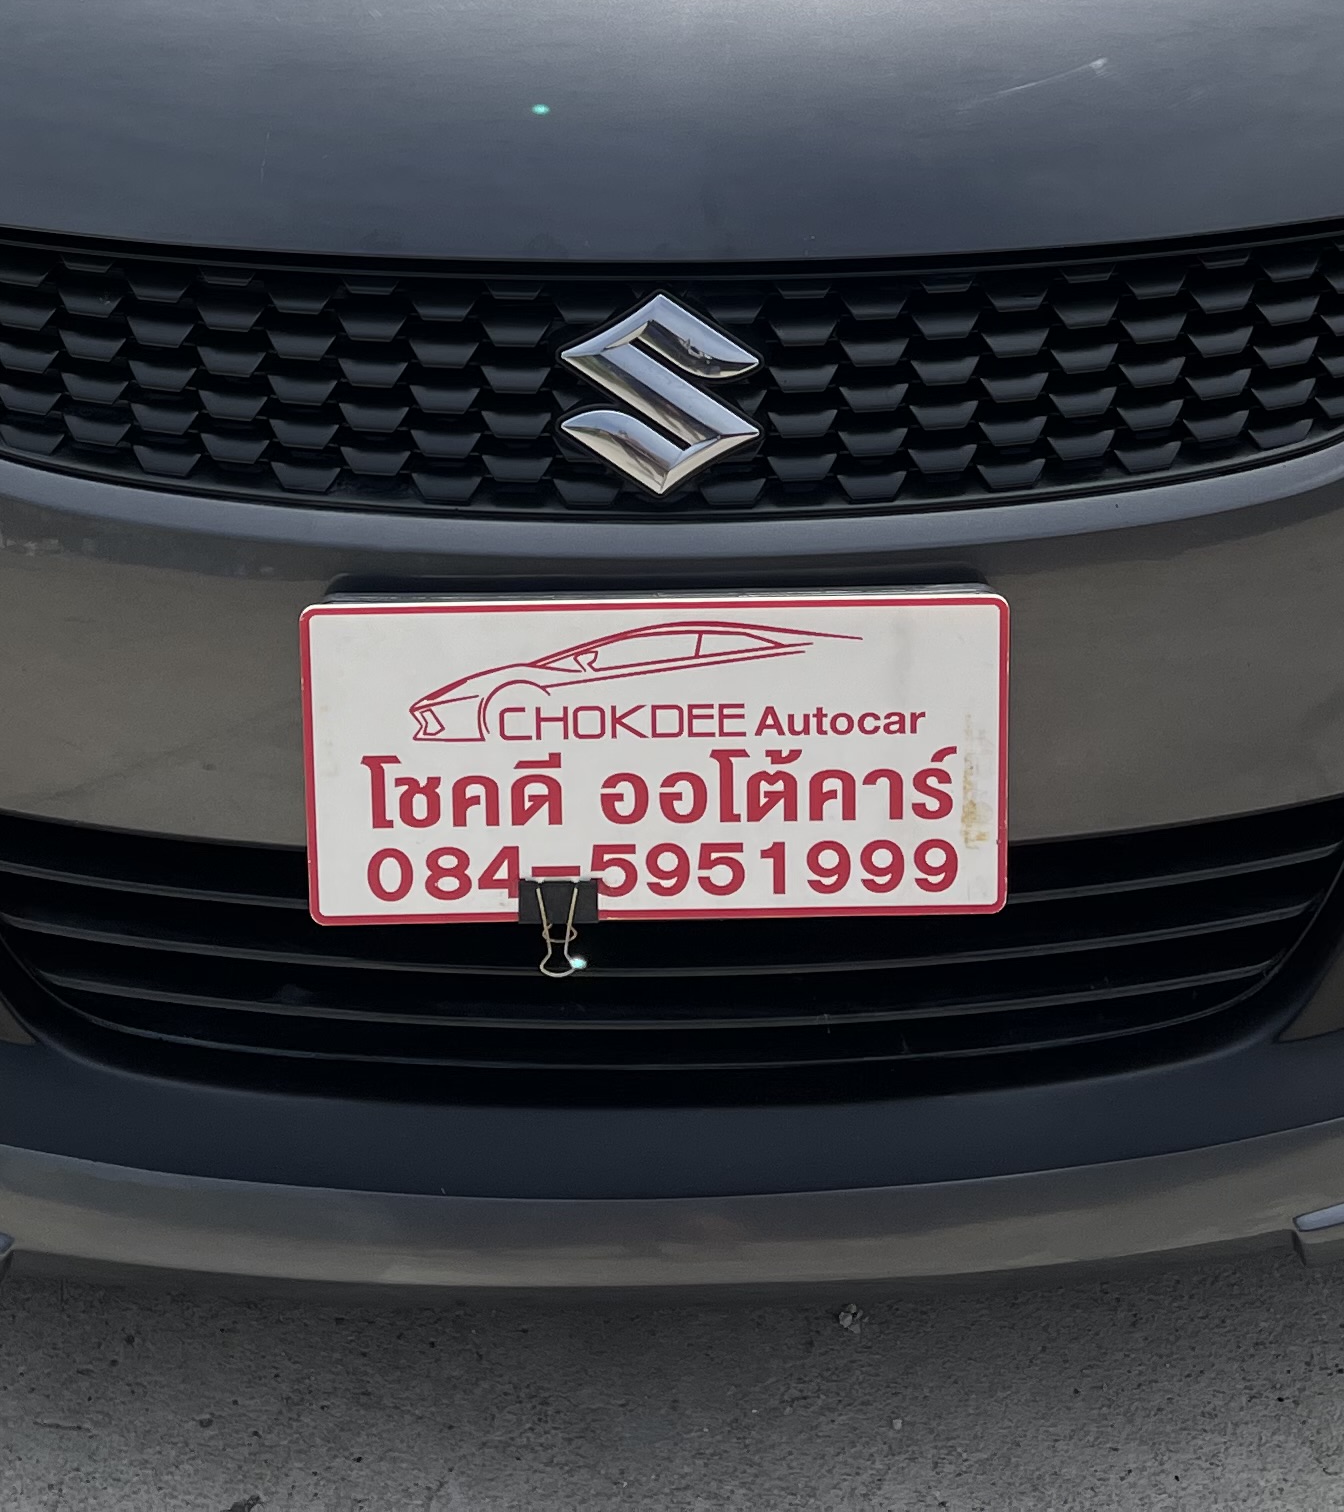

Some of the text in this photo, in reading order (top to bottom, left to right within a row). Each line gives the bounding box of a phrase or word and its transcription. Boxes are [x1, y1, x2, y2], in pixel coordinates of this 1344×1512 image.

[498, 703, 927, 741] CHOKDEE Autocar
[361, 745, 958, 830] โชคดี ออโต้คาร์
[367, 837, 959, 902] 084-5951999
